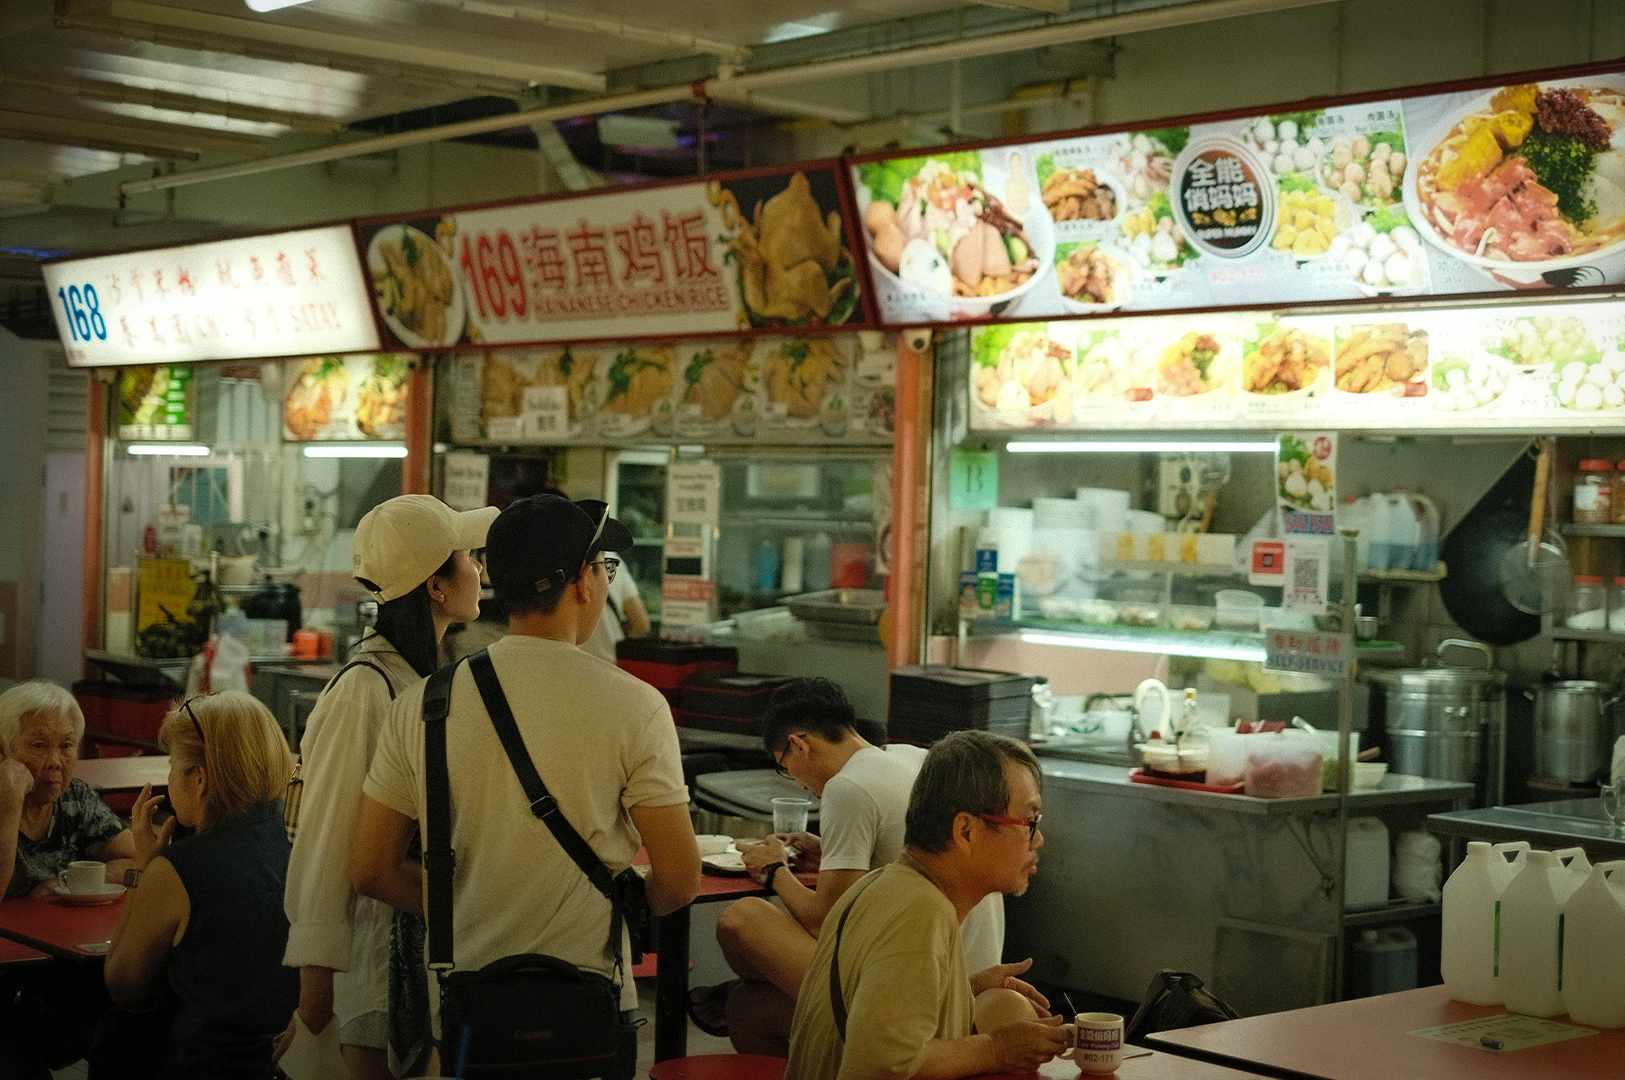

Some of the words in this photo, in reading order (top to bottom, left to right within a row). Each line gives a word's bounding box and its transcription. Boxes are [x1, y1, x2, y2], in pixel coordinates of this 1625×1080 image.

[1187, 157, 1245, 188] 全能
[1183, 182, 1259, 213] 俏妈妈
[520, 209, 718, 289] 海南鸡饭
[460, 230, 527, 319] 169
[58, 283, 107, 341] 168
[534, 293, 612, 317] HAINANESE
[618, 289, 684, 312] CHICKEN
[687, 285, 728, 308] RICE
[1084, 1053, 1113, 1062] #02-171
